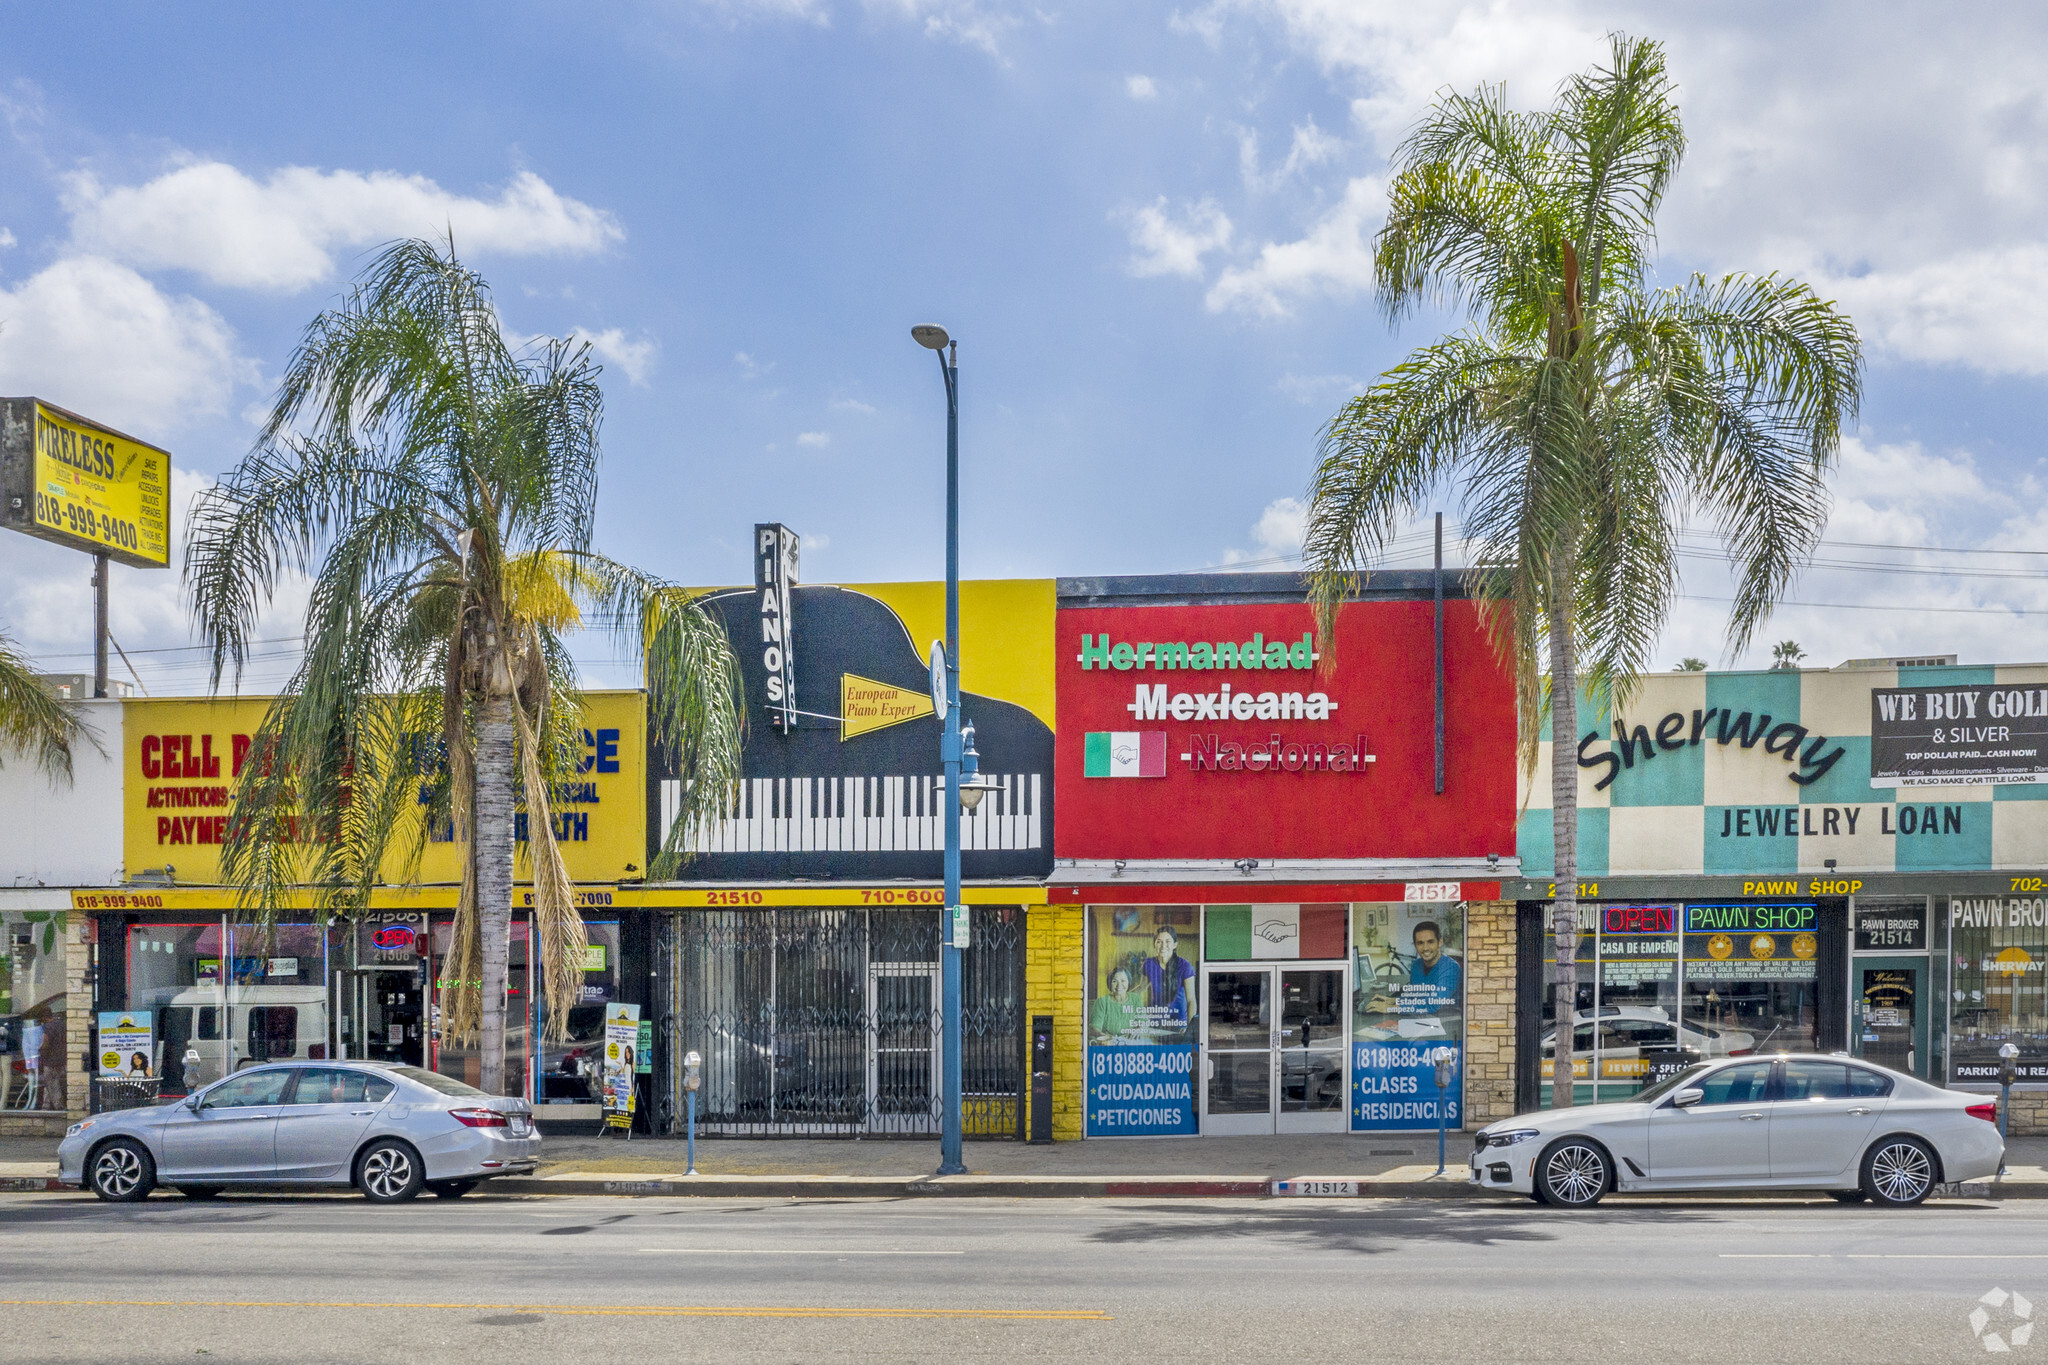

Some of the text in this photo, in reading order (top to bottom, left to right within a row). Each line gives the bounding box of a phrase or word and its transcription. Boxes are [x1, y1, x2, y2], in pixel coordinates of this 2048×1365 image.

[37, 412, 115, 480] WIRELESS
[37, 490, 138, 550] 818-999-9400
[759, 529, 784, 702] PIANOS
[1082, 632, 1312, 670] Hermandad
[847, 686, 898, 704] European
[1135, 683, 1329, 720] Mexicana
[847, 702, 916, 718] Piano Expert
[1877, 694, 1917, 722] WE
[1925, 691, 1981, 720] BUY
[1932, 726, 2010, 743] & SILVER
[141, 733, 220, 779] CELL
[1189, 733, 1368, 772] Nacional
[1577, 707, 1846, 792] Sherway
[1924, 751, 1958, 760] DOLLAR
[2011, 749, 2037, 757] NOW!
[1906, 768, 1925, 776] Coins
[1931, 767, 1955, 776] Musical
[1955, 767, 1993, 776] Instruments
[1995, 765, 2029, 774] Silverware
[1902, 775, 2037, 786] WE ALSO MAKE CAR TITLE LOANS
[146, 786, 229, 808] ACTIVATIONS
[1720, 805, 1962, 838] JEWELRY LOAN
[1405, 883, 1460, 900] 21512
[1743, 880, 1798, 897] PAWN
[76, 895, 163, 908] 818-999-9400
[707, 891, 763, 905] 21510
[1607, 907, 1673, 931] OPEN
[1690, 906, 1815, 929] PAWN SHOP
[1951, 900, 2004, 928] PAWN
[1862, 919, 1919, 930] PAWN BROKER
[373, 930, 413, 945] OPEN
[1710, 935, 1731, 946] GOLD
[1795, 935, 1816, 944] COINS
[1870, 931, 1912, 945] 21514
[1600, 939, 1679, 954] CASA DE EMPEÑO
[1751, 947, 1775, 958] SILVER
[1982, 961, 2046, 972] SHERWAY
[1873, 971, 1907, 982] Welcome
[1389, 983, 1401, 992] Mi
[1402, 982, 1436, 992] camino
[1122, 1005, 1133, 1013] Mi
[1136, 1004, 1169, 1014] camino
[1395, 997, 1456, 1005] Estados Unidos
[1129, 1019, 1188, 1027] Estados Unidos
[1092, 1052, 1192, 1077] (818)888-4000
[1097, 1083, 1191, 1101] CIUDADANIA
[1361, 1075, 1418, 1095] CLASES
[1098, 1108, 1182, 1126] PETICIONES
[1361, 1100, 1458, 1120] RESIDENCIAS
[1303, 1181, 1348, 1194] 21512
